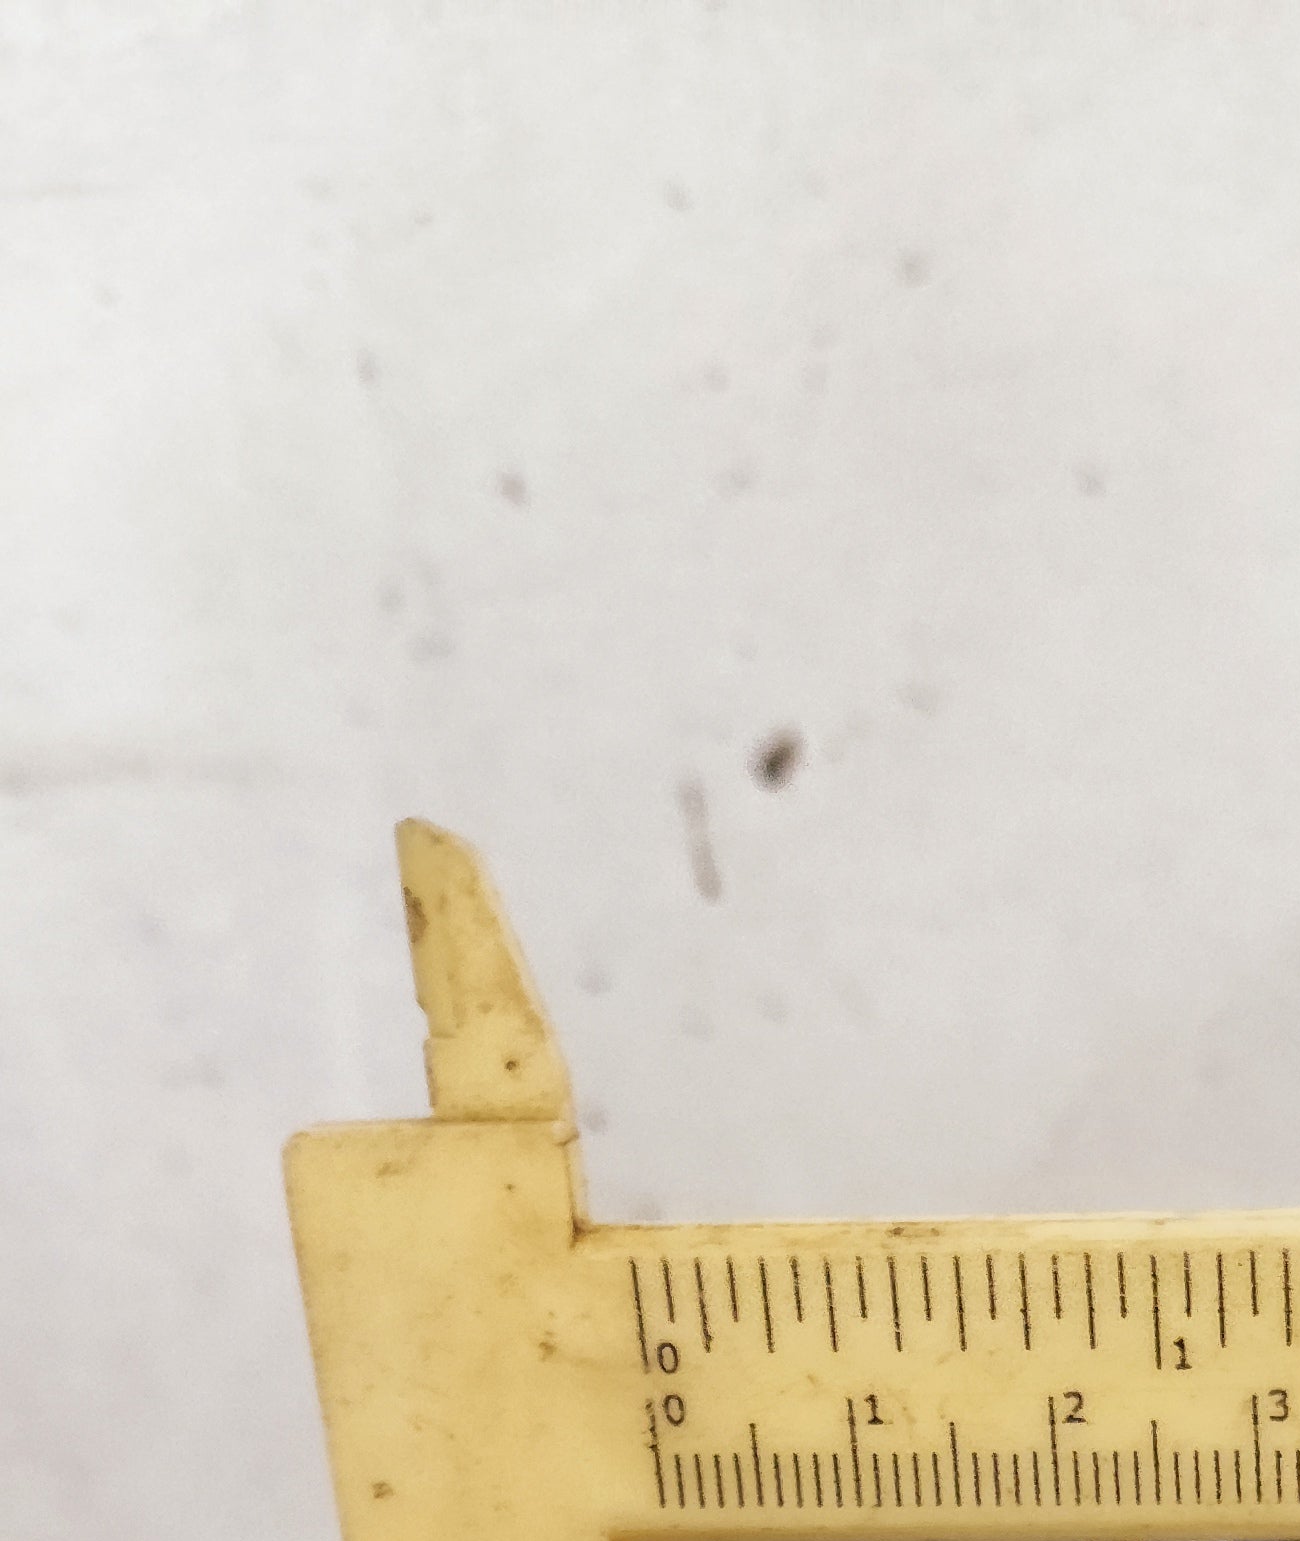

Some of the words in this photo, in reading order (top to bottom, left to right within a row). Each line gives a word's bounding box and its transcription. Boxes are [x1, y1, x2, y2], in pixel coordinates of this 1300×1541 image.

[656, 1341, 680, 1375] 0
[1173, 1337, 1192, 1371] 1
[661, 1393, 686, 1427] 0
[864, 1393, 885, 1426] 1
[1062, 1391, 1087, 1424] 2
[1268, 1388, 1290, 1422] 3
